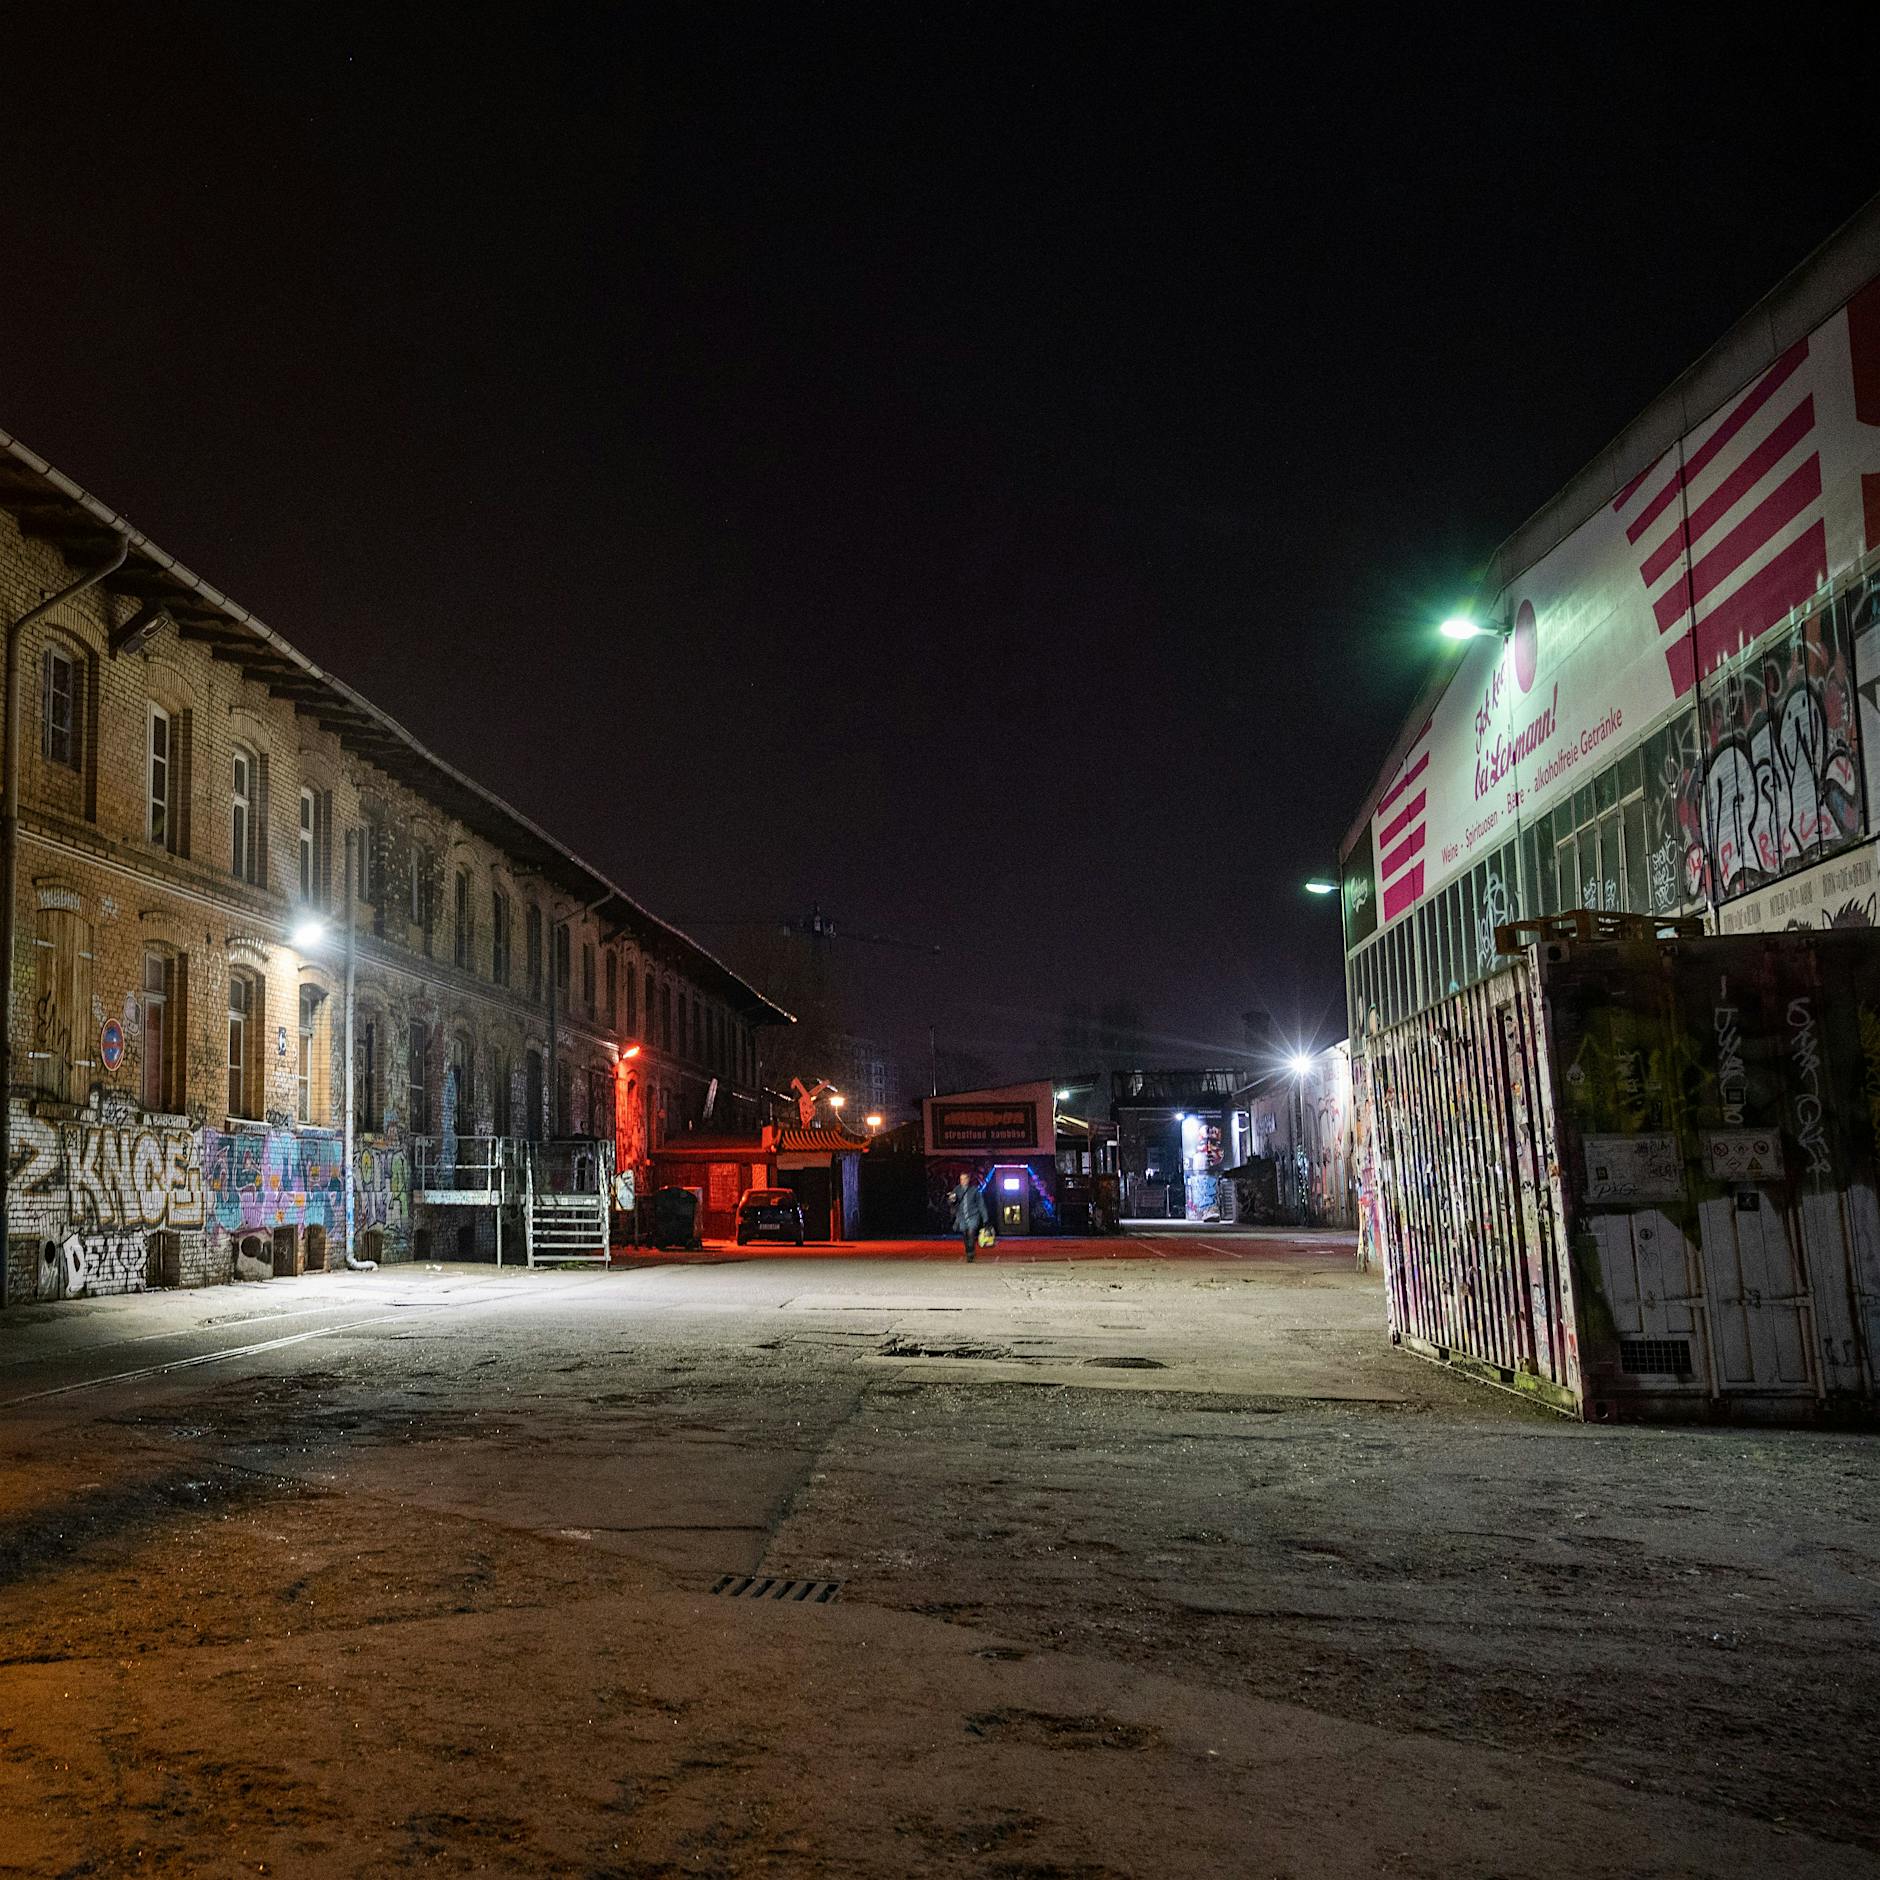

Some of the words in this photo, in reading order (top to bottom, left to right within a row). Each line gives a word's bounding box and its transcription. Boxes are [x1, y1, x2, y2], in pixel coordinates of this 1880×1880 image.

[1441, 842, 1459, 865] Weine
[1465, 811, 1498, 850] Spirituosen
[1534, 740, 1579, 793] alkoholfreie
[1580, 707, 1623, 757] Getränke
